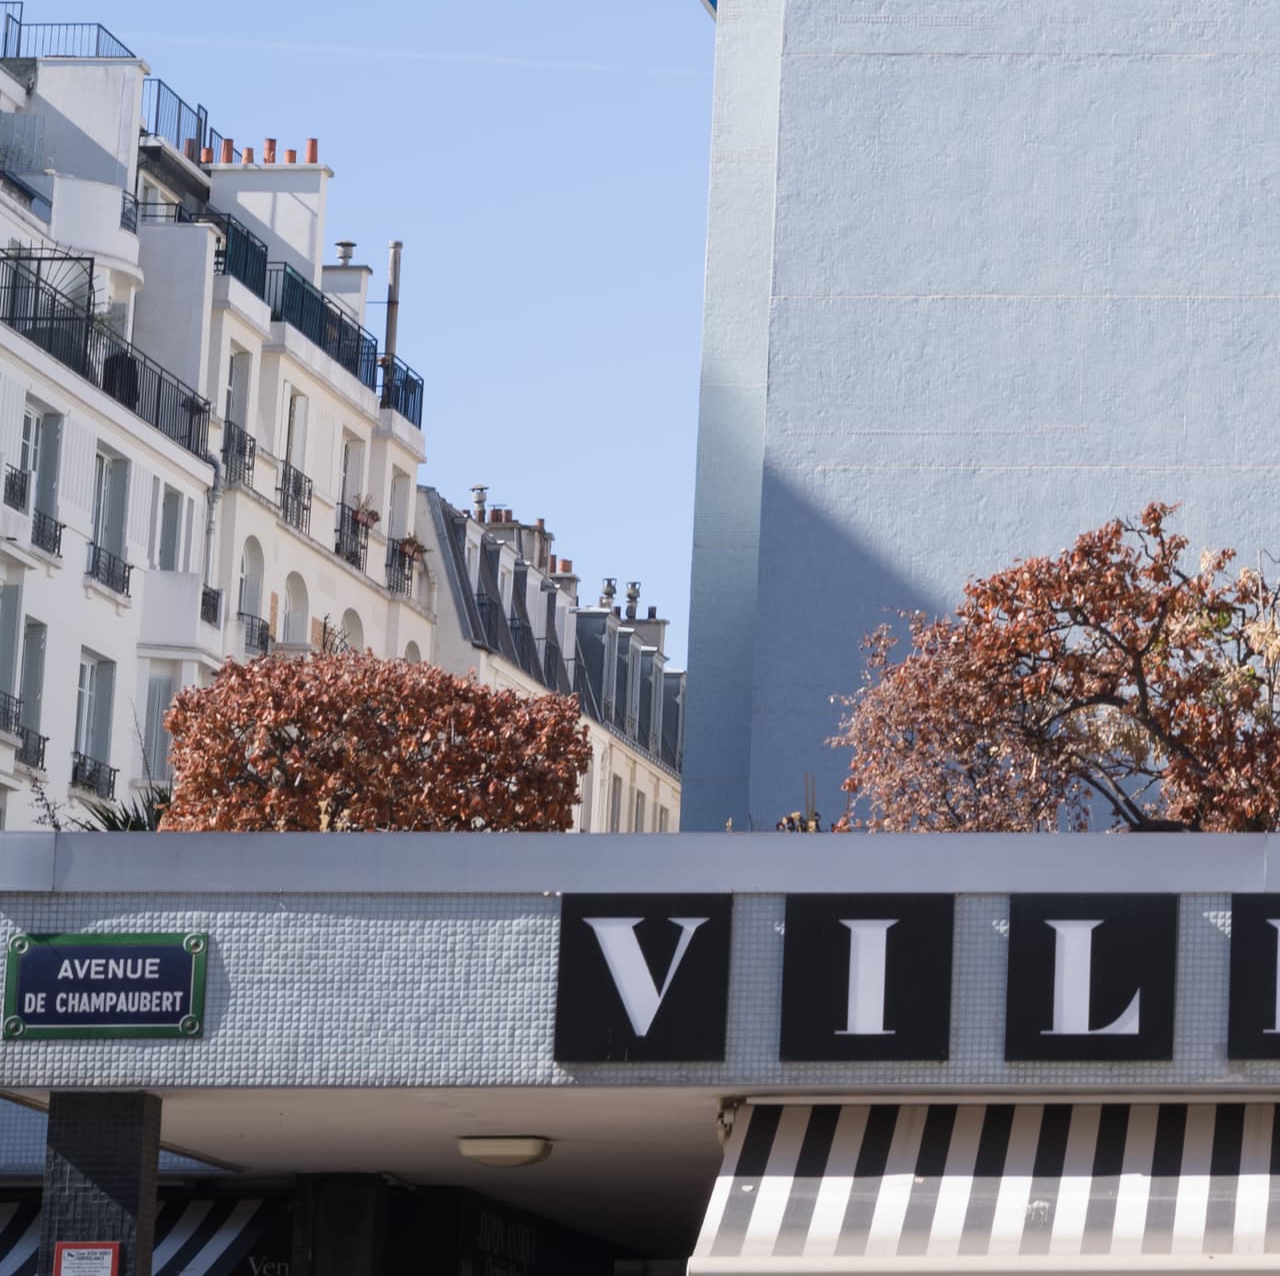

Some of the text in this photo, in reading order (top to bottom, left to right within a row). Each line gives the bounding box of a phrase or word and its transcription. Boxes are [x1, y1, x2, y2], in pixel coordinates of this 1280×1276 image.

[57, 958, 161, 980] AVENUE
[24, 991, 184, 1014] DE CHAMPAUBERT
